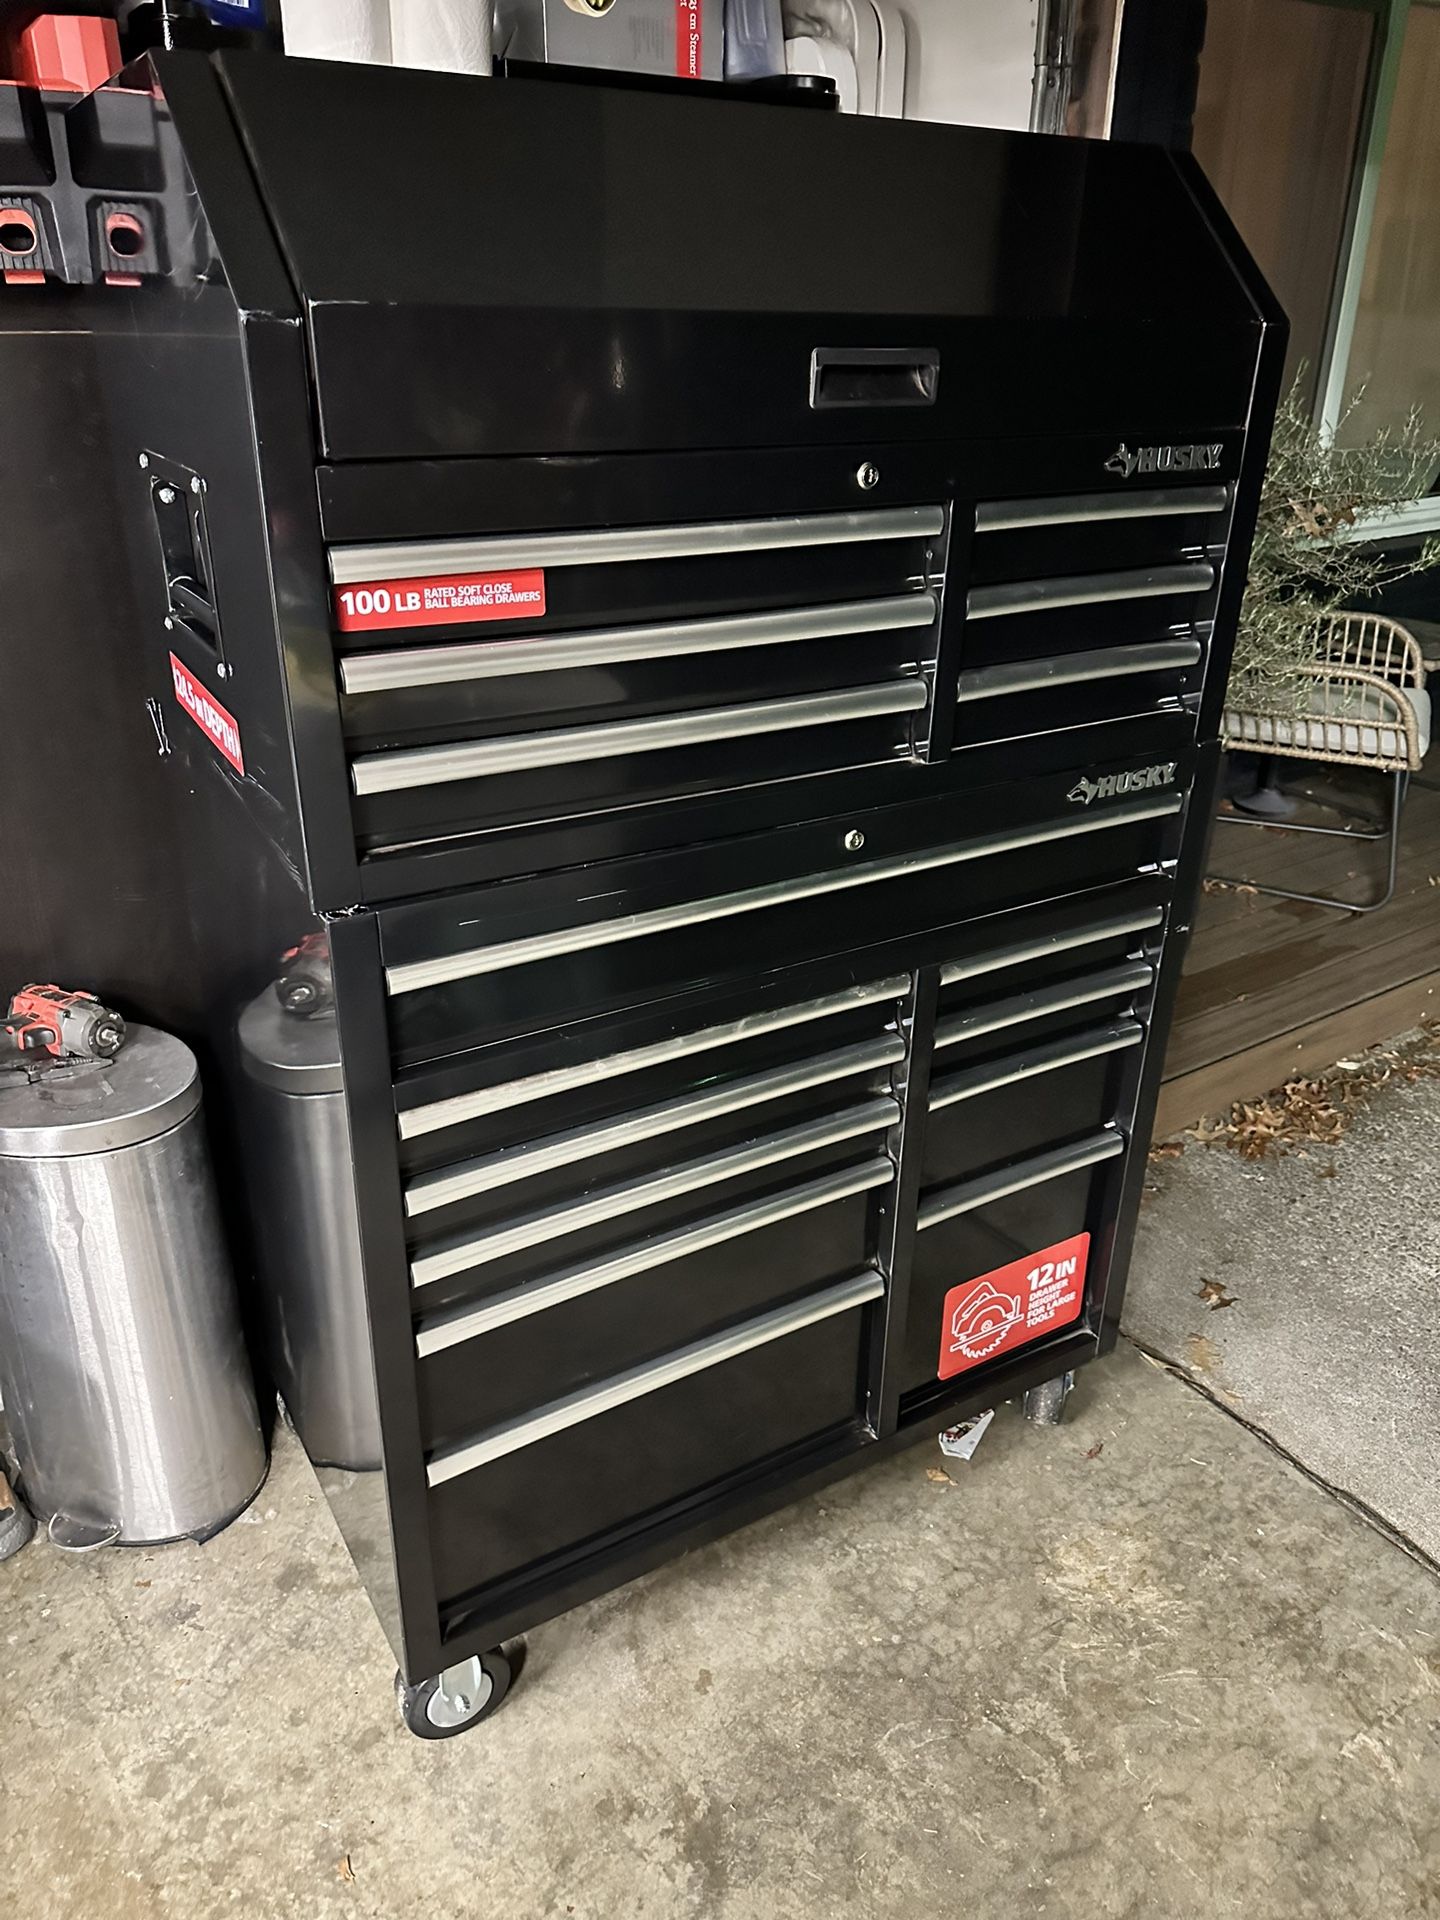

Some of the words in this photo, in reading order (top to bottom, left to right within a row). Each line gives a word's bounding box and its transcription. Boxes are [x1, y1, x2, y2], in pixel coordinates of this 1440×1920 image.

[689, 13, 697, 30] cm
[689, 33, 700, 76] Steamer
[1137, 444, 1223, 473] HUSKY
[340, 588, 391, 616] 100
[394, 591, 422, 612] LB
[423, 587, 456, 599] RATED
[457, 584, 482, 596] SOFT
[483, 583, 513, 595] CLOSE
[424, 597, 450, 609] BALL
[451, 594, 494, 607] BEARING
[495, 590, 541, 604] DRAWERS
[1097, 762, 1178, 798] HUSKY
[1028, 1278, 1069, 1302] DRAWER
[1028, 1289, 1062, 1311] HEIGHT
[1026, 1304, 1046, 1320] FOR
[1046, 1291, 1076, 1311] LARGE
[1025, 1309, 1056, 1328] TOOLS
